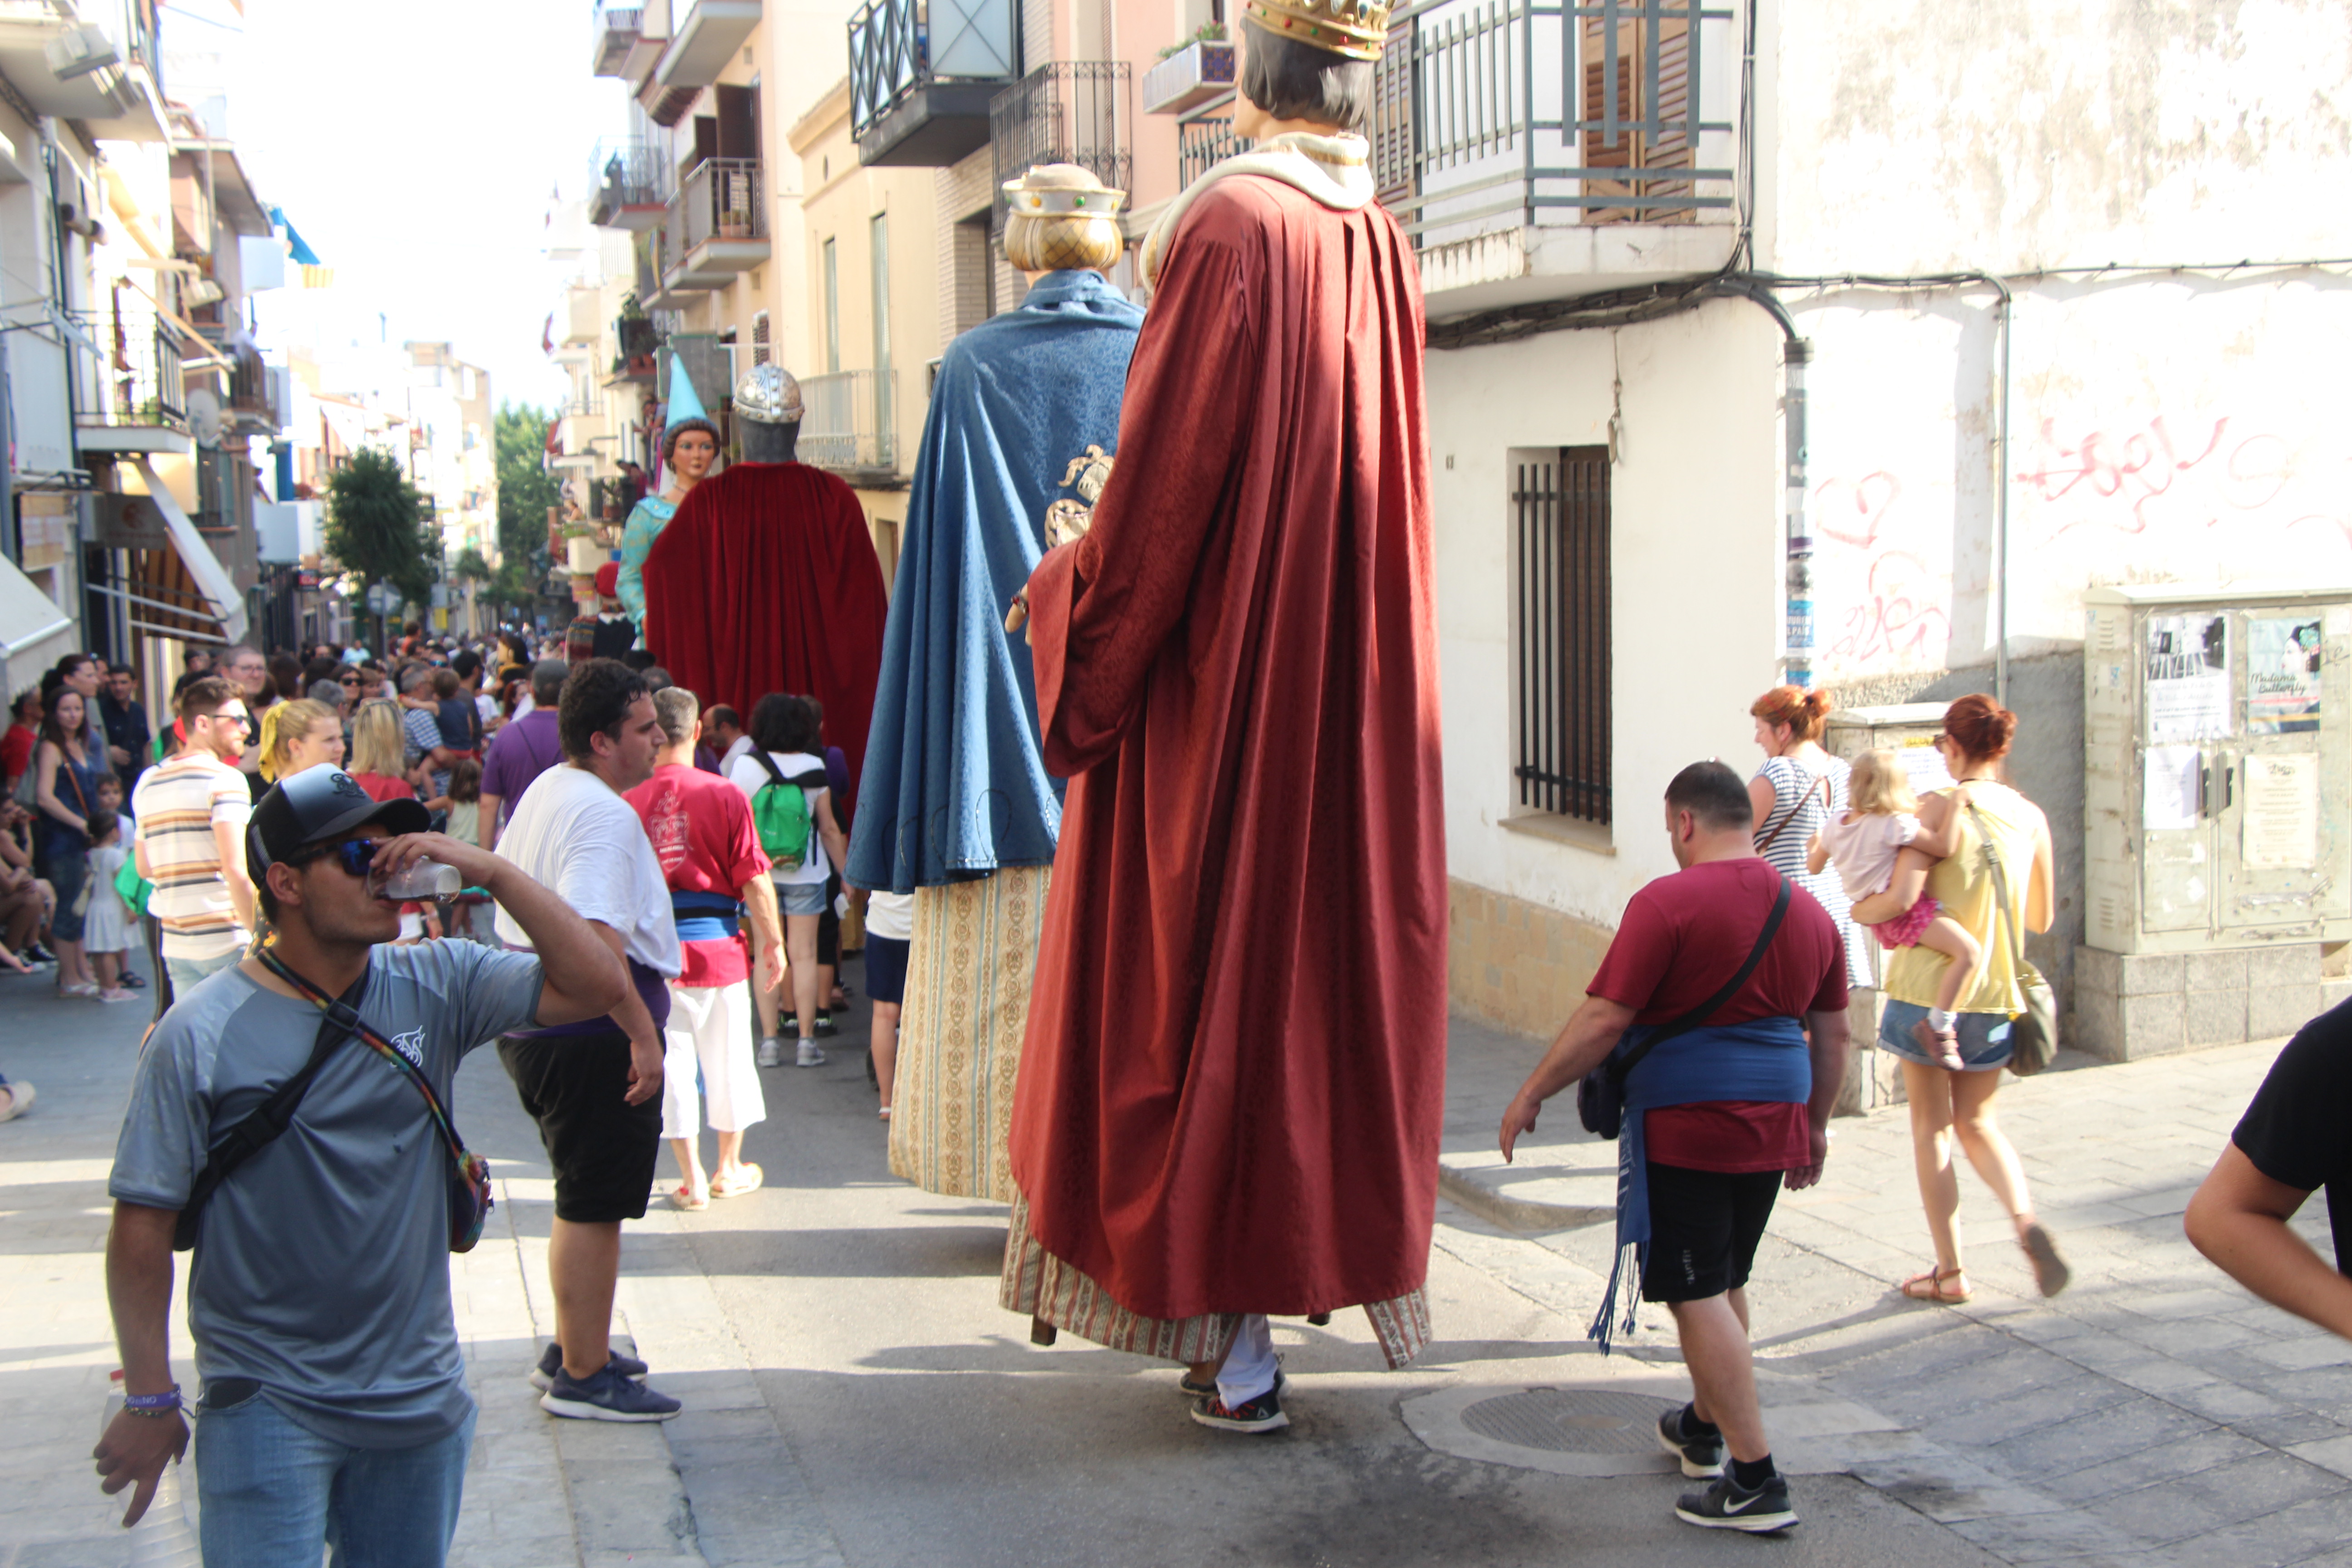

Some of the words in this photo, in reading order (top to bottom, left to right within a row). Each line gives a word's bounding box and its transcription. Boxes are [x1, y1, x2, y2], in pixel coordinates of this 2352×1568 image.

[2250, 672, 2297, 683] Madama
[2258, 681, 2307, 696] Butterfly
[142, 1396, 157, 1404] NO
